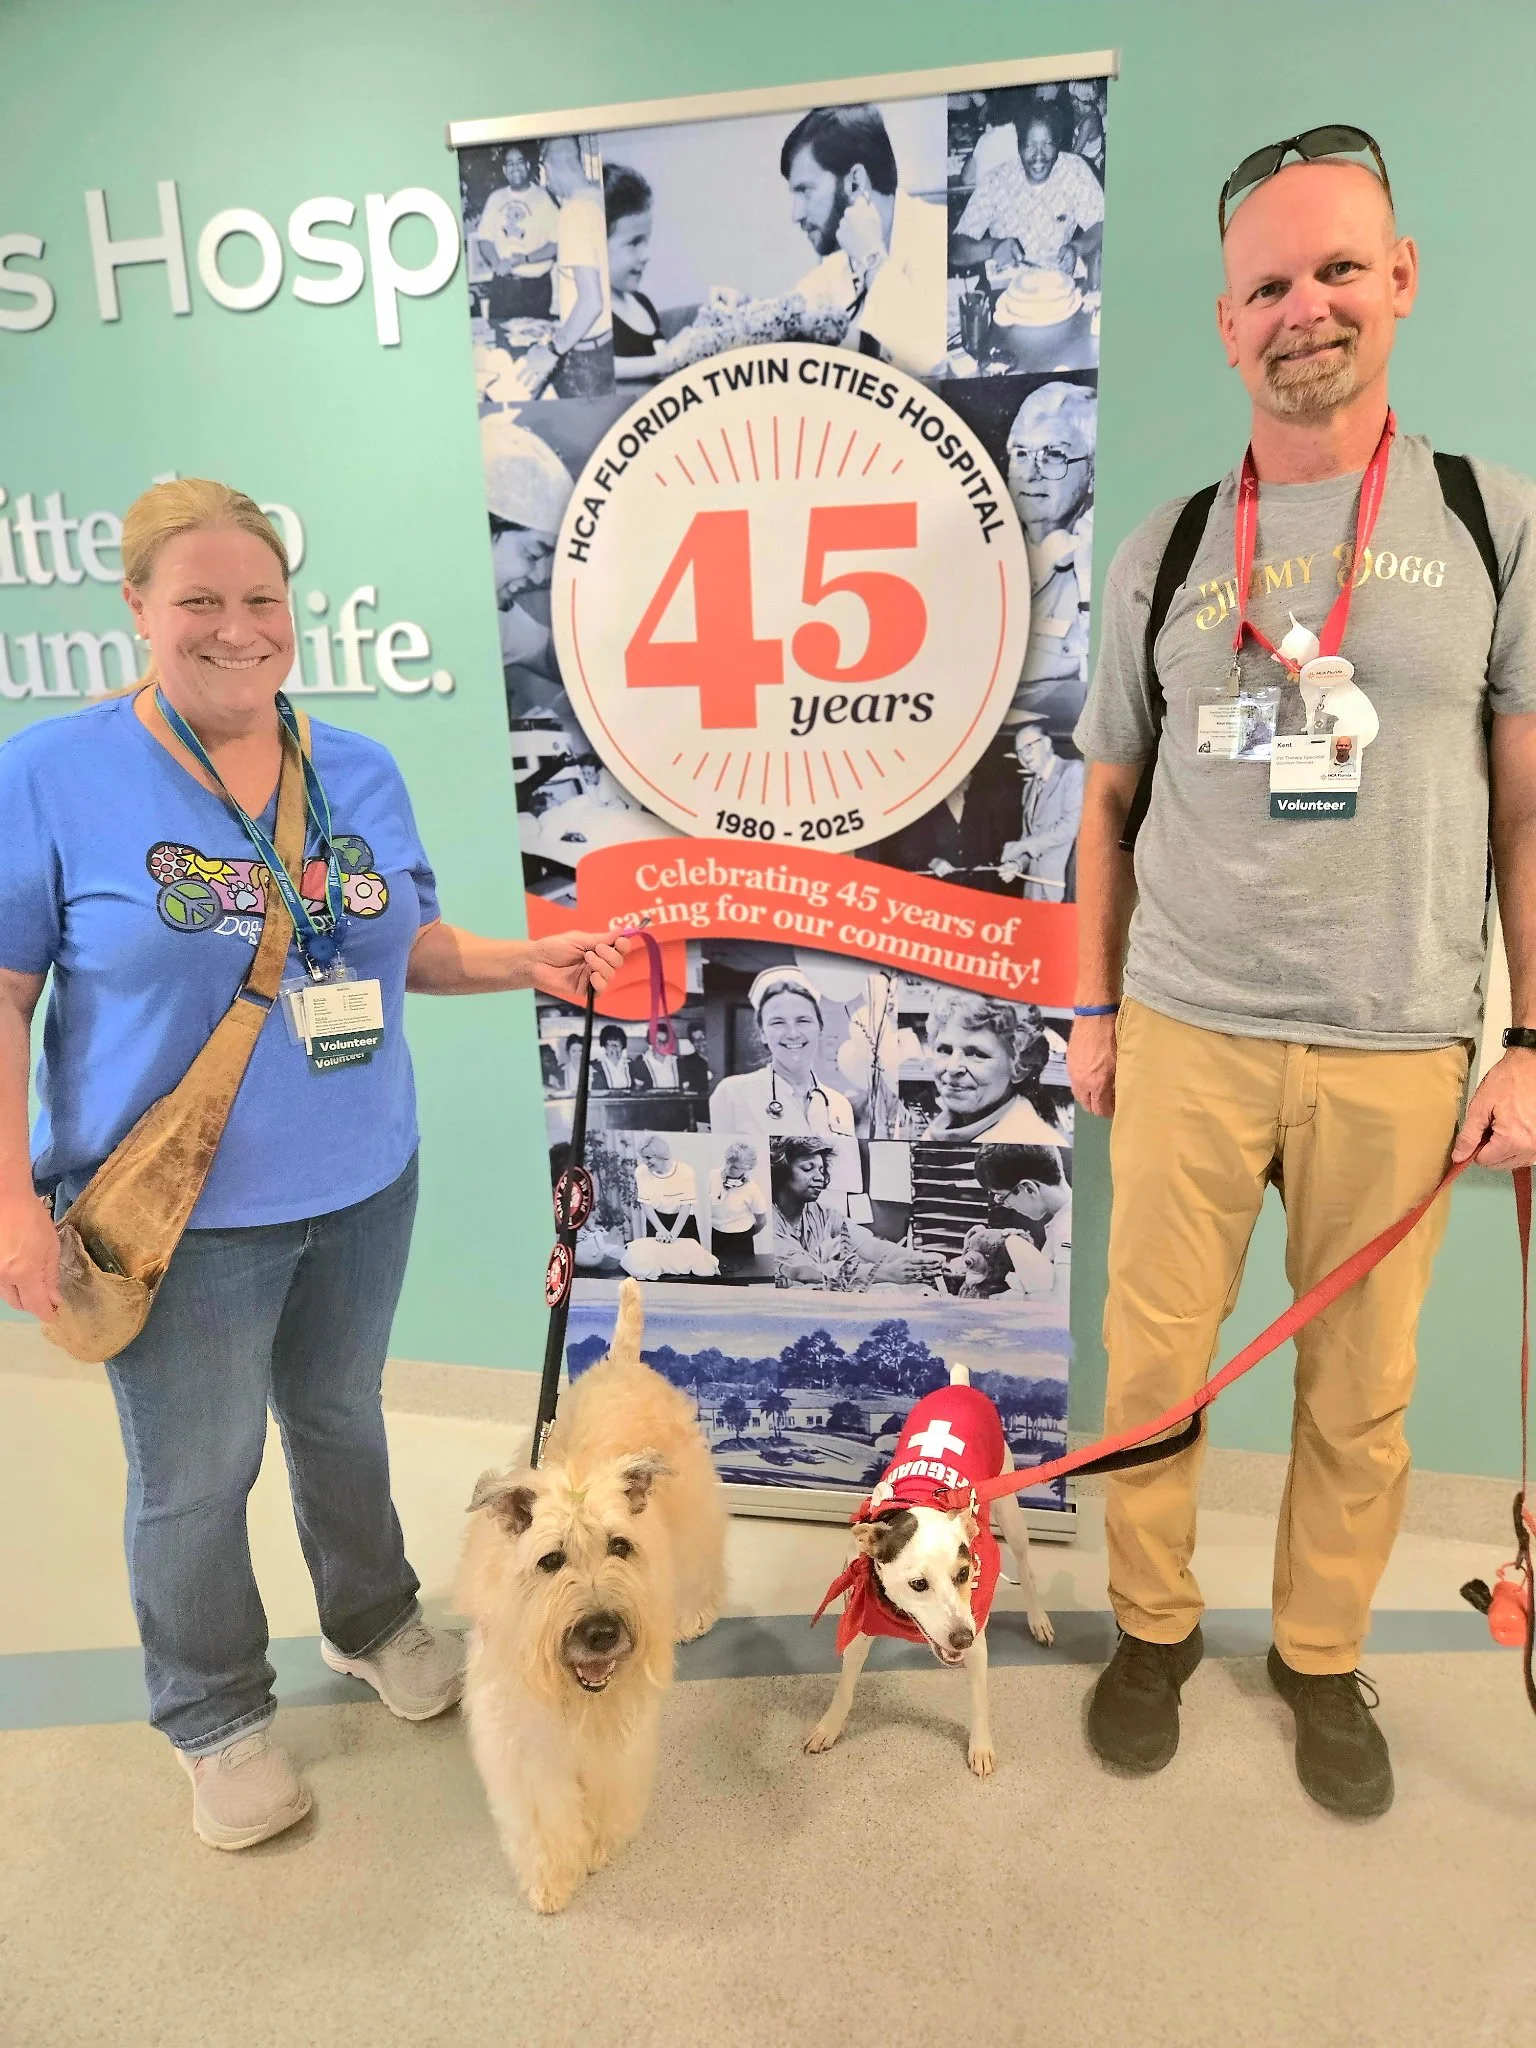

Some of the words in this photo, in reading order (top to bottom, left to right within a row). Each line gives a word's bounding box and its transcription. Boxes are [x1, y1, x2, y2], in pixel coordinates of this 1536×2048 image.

[85, 180, 461, 346] Hosp
[567, 496, 605, 564] HCA
[599, 385, 702, 492] FLORIDA
[702, 358, 789, 398] TWIN
[798, 358, 899, 410] CITIES
[898, 396, 1005, 544] HOSPITAL
[624, 502, 928, 730] 45
[790, 691, 935, 736] years
[715, 810, 775, 841] 1980
[800, 809, 865, 841] 2025
[1277, 799, 1346, 811] Volunteer
[635, 856, 831, 907] Celebrating
[836, 880, 880, 912] 45
[884, 892, 975, 939] years
[981, 917, 1021, 947] of
[716, 894, 767, 925] for
[772, 909, 834, 941] our
[838, 921, 1041, 989] community!
[319, 1037, 378, 1052] Volunteer
